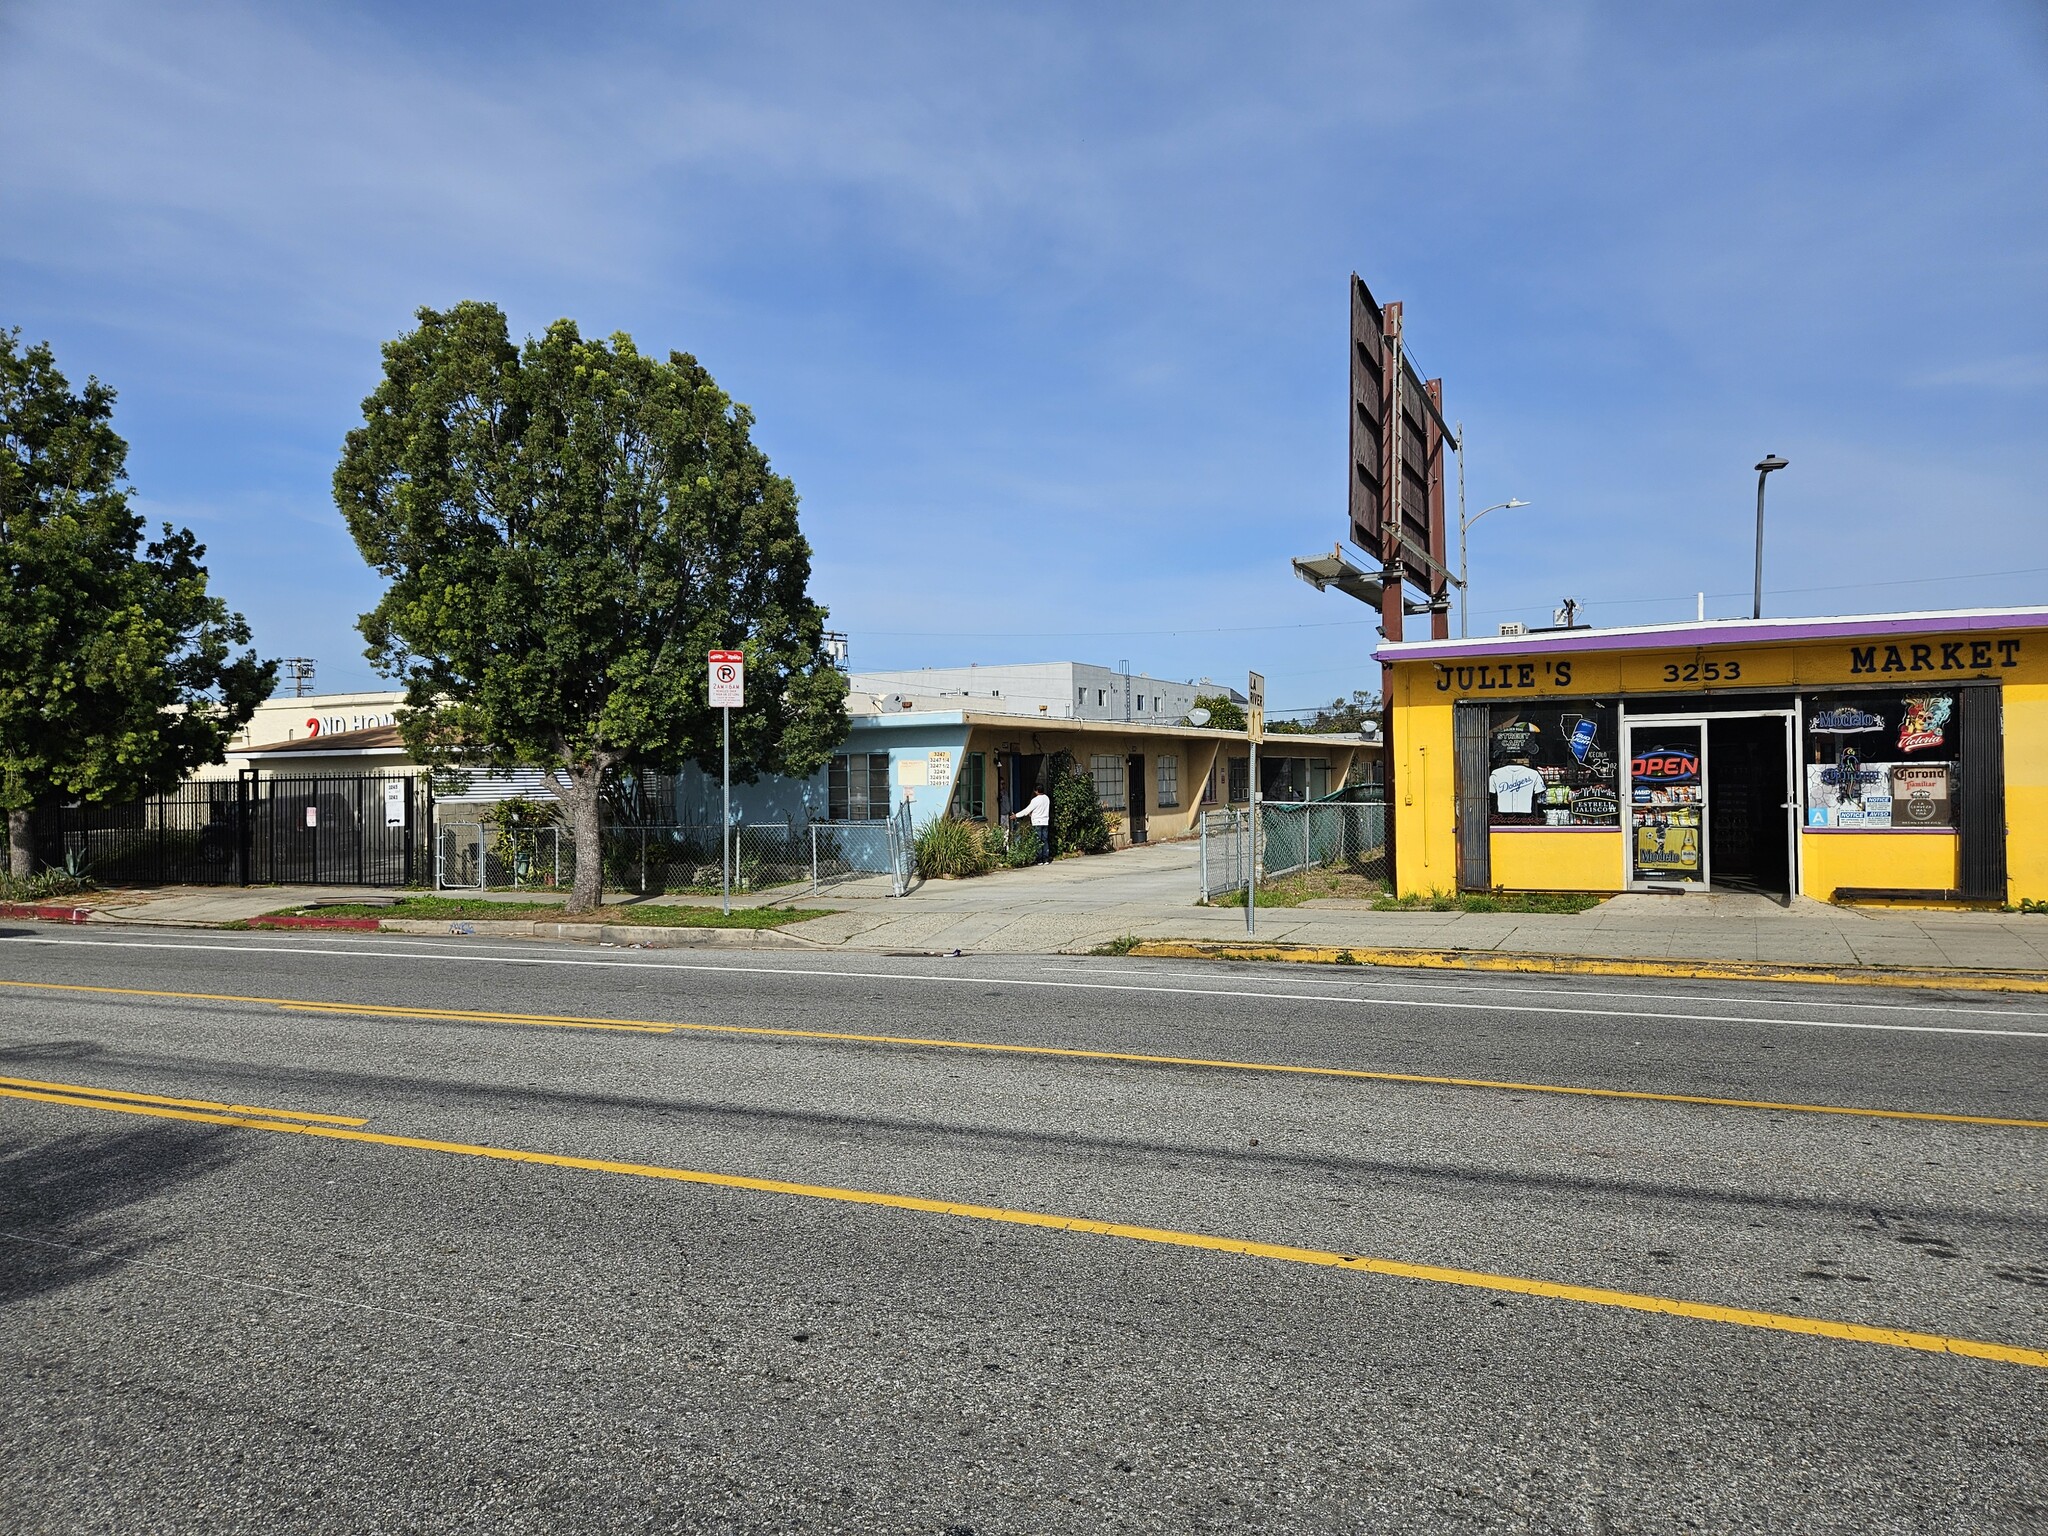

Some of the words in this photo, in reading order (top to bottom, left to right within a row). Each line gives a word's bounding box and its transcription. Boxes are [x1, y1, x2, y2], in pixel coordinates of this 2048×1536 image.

[1850, 640, 2020, 674] MARKET
[1663, 662, 1741, 682] 3253
[1250, 677, 1256, 691] LA
[1250, 692, 1262, 707] RIVER
[1819, 710, 1874, 727] Modelo
[306, 714, 346, 738] 2ND
[1572, 736, 1590, 745] LIGHT
[1898, 734, 1940, 748] Victoria
[1593, 758, 1609, 769] 25
[1631, 757, 1699, 775] OPEN
[1894, 768, 1944, 781] Corona
[1499, 776, 1533, 793] Dodgers
[1904, 781, 1936, 791] Familiar
[1813, 812, 1824, 823] A
[1640, 849, 1680, 863] Modelo
